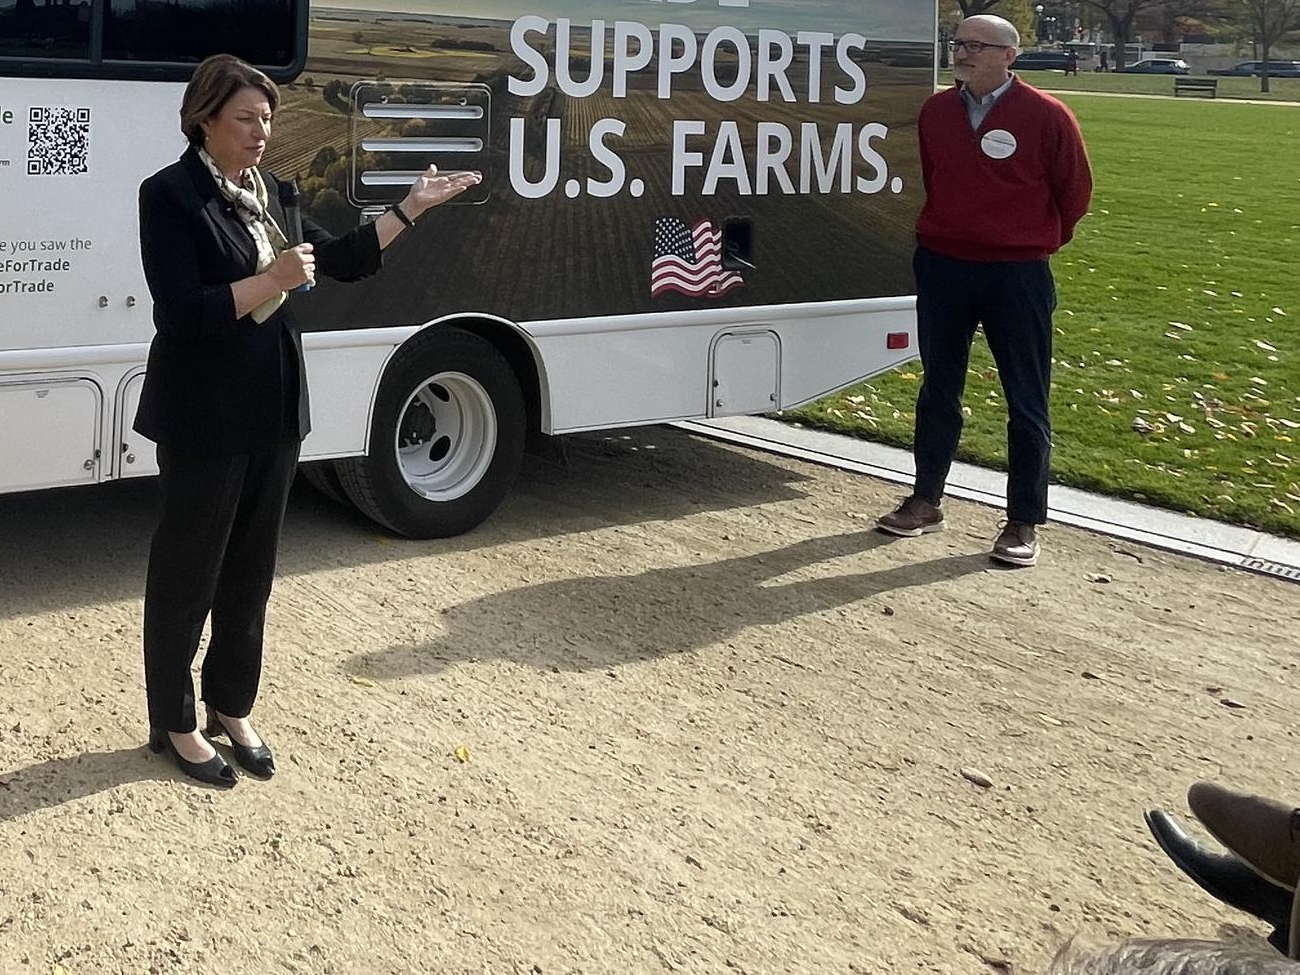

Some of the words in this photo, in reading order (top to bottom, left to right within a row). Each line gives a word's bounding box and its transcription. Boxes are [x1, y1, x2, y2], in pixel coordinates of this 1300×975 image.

[507, 15, 867, 105] SUPPORTS
[508, 117, 645, 199] U.S.
[670, 120, 904, 196] FARMS.
[10, 240, 37, 257] you
[40, 239, 67, 252] saw
[70, 237, 93, 252] the
